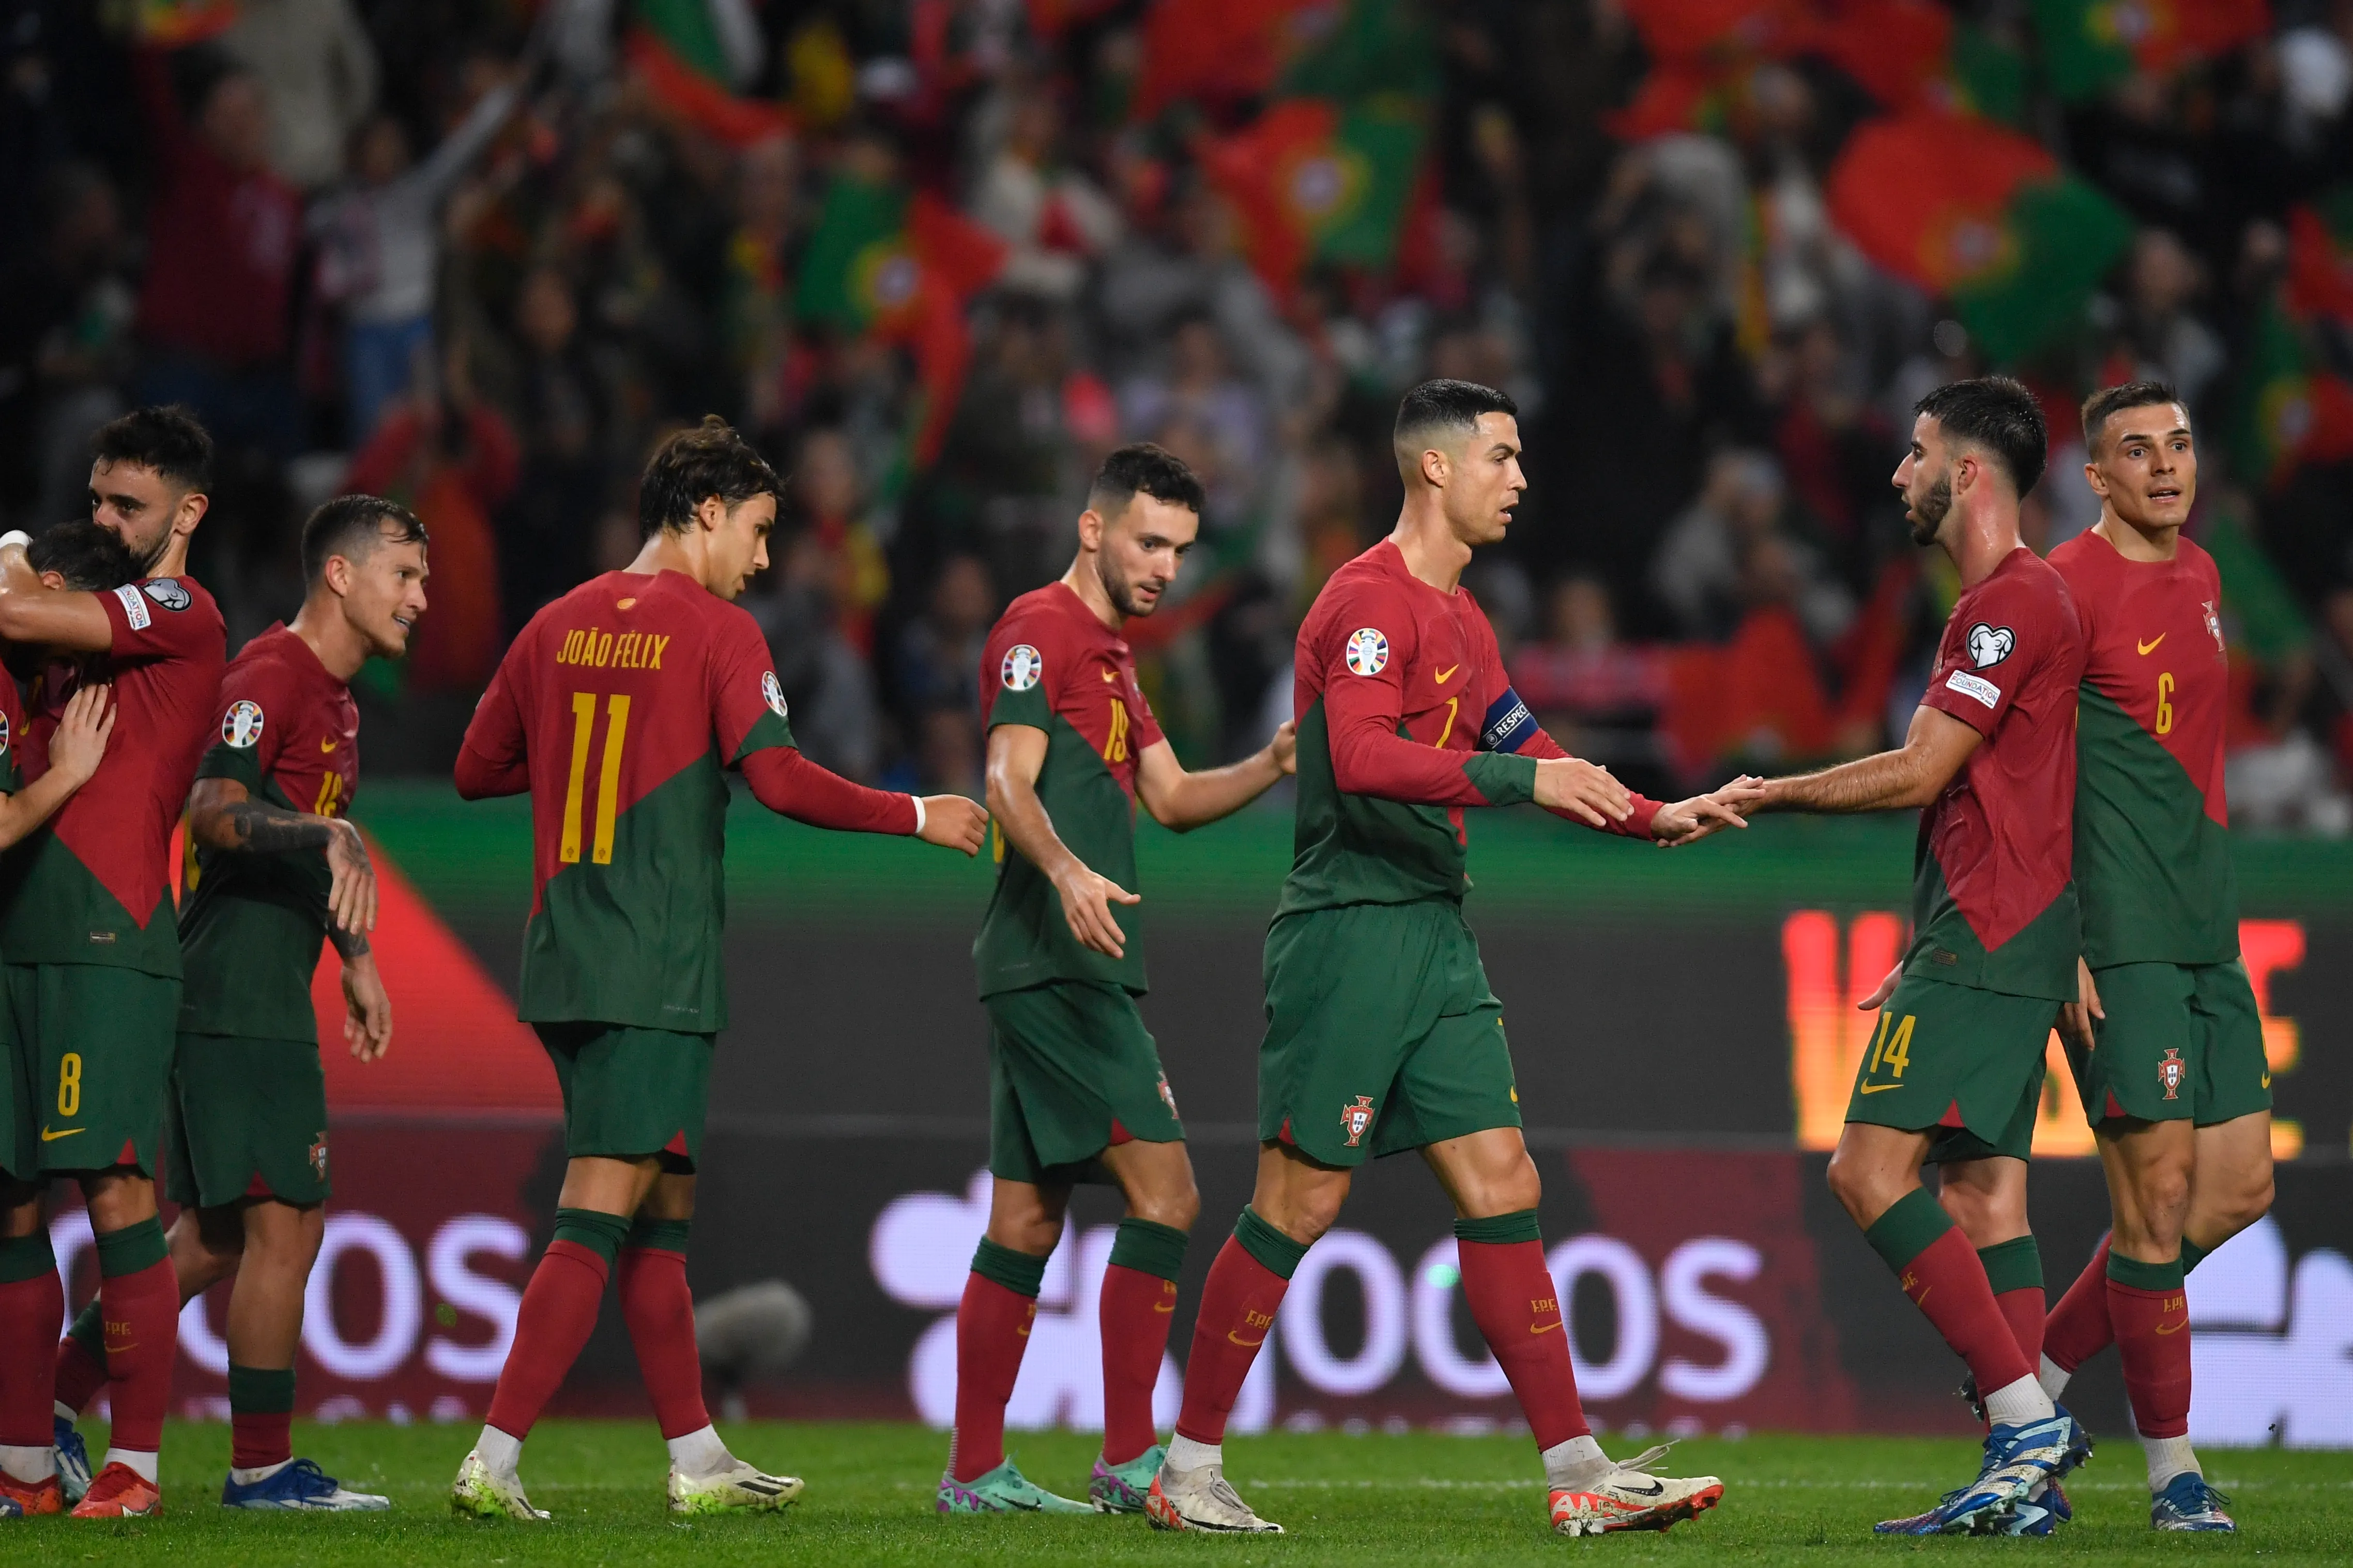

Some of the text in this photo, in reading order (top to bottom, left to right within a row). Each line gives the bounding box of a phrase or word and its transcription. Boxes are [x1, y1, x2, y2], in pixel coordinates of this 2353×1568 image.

[557, 627, 670, 669] JOÃO FÉLIX
[1951, 675, 1997, 702] FOUNDATION
[2156, 672, 2175, 734] 6
[1104, 698, 1128, 762] 19
[1435, 697, 1458, 748] 7
[560, 692, 631, 865] 11
[1869, 1011, 1916, 1078] 14
[58, 1052, 81, 1116] 8
